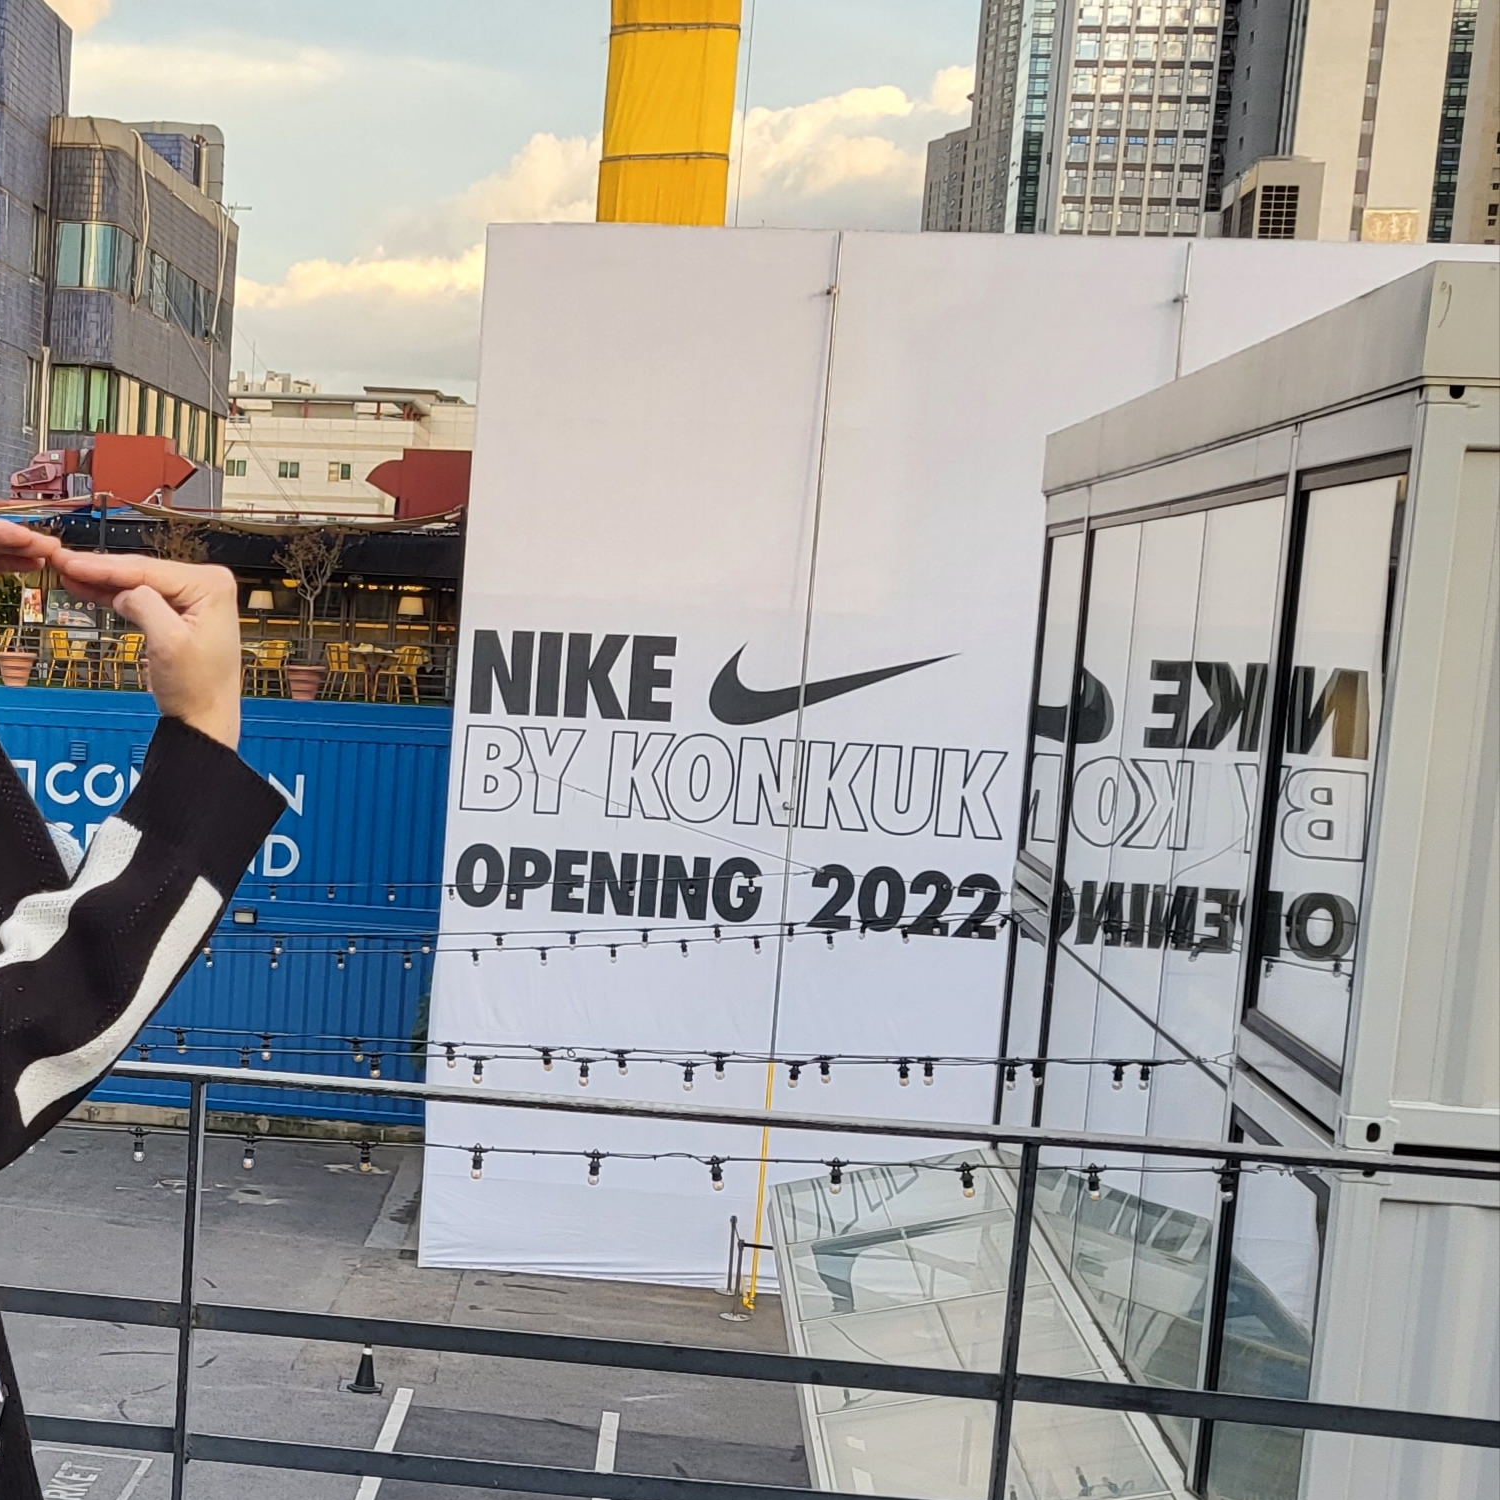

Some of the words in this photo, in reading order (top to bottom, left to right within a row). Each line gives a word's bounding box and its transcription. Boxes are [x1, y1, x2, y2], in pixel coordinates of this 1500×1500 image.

[469, 629, 677, 723] NIKE
[459, 724, 587, 816] BY
[604, 730, 1009, 841] KONKUK
[455, 843, 763, 924] OPENING
[805, 863, 1002, 941] 2022
